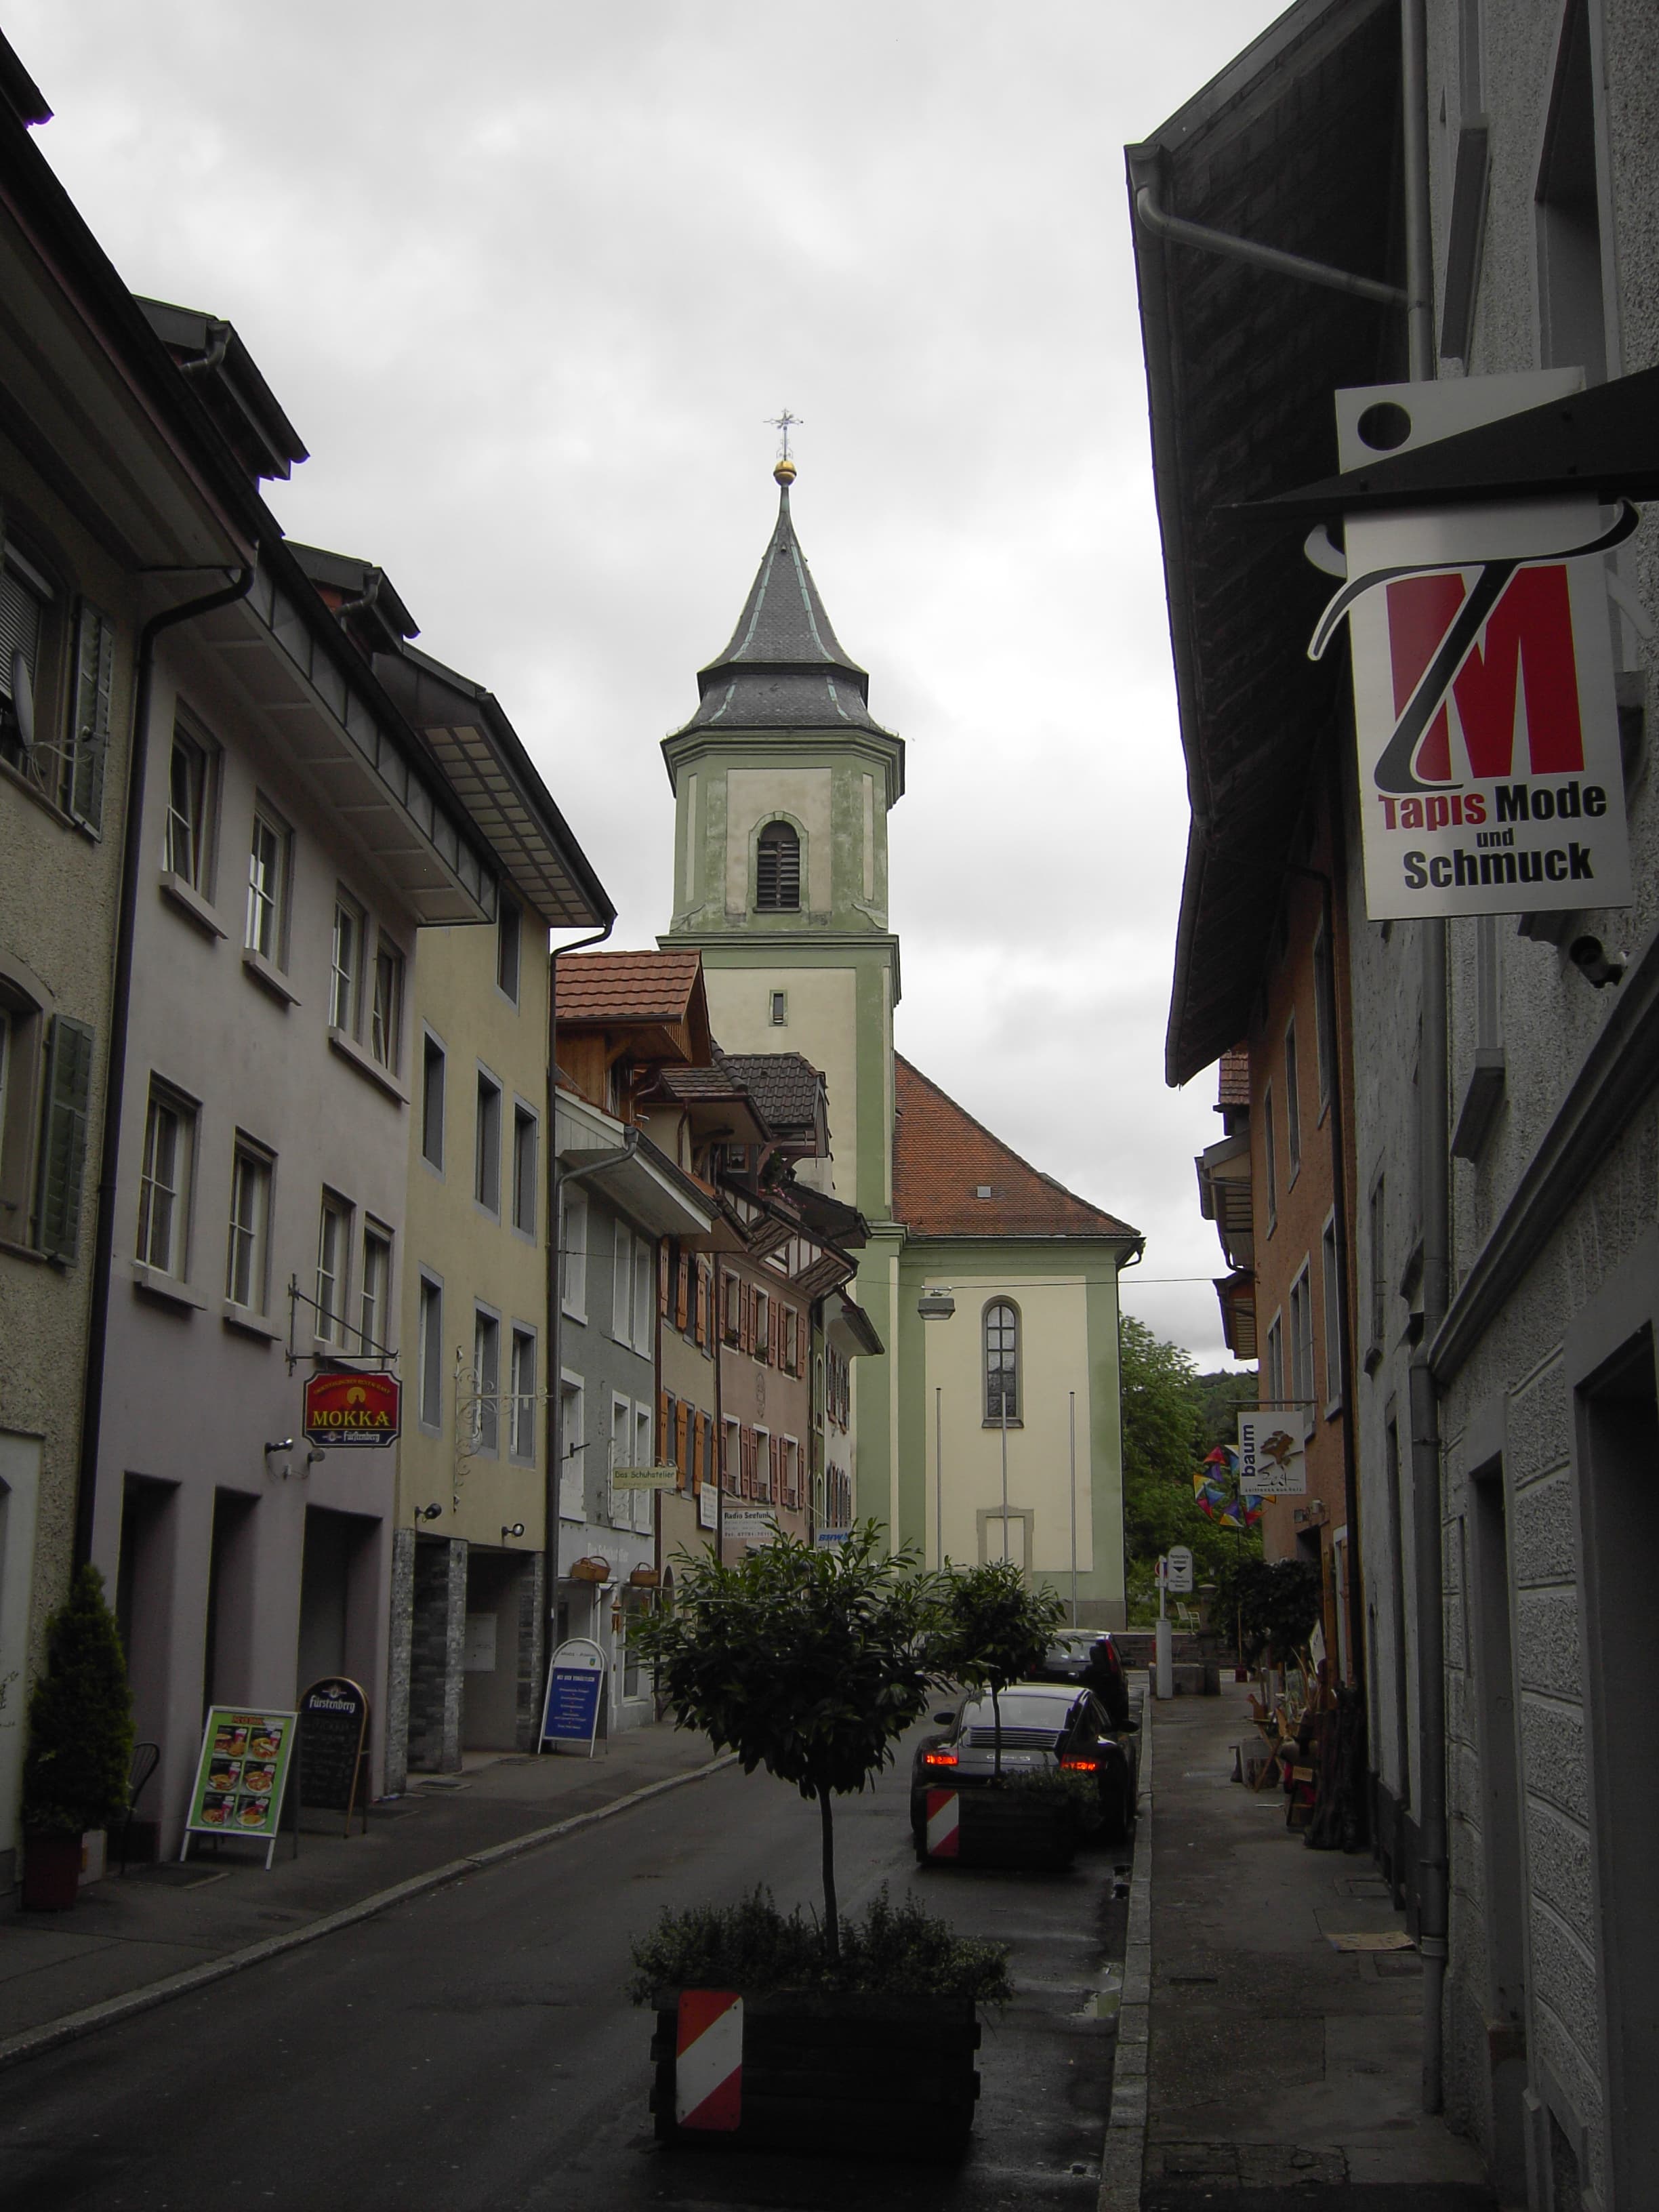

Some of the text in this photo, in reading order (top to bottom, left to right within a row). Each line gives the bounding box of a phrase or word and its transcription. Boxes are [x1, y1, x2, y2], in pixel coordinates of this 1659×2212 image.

[1379, 781, 1607, 832] Tapis Mode
[1477, 827, 1514, 848] und
[1404, 841, 1593, 890] Schmuck
[312, 1410, 390, 1427] MOKKA
[1241, 1425, 1256, 1477] baum
[631, 1470, 674, 1478] Schuhatelier
